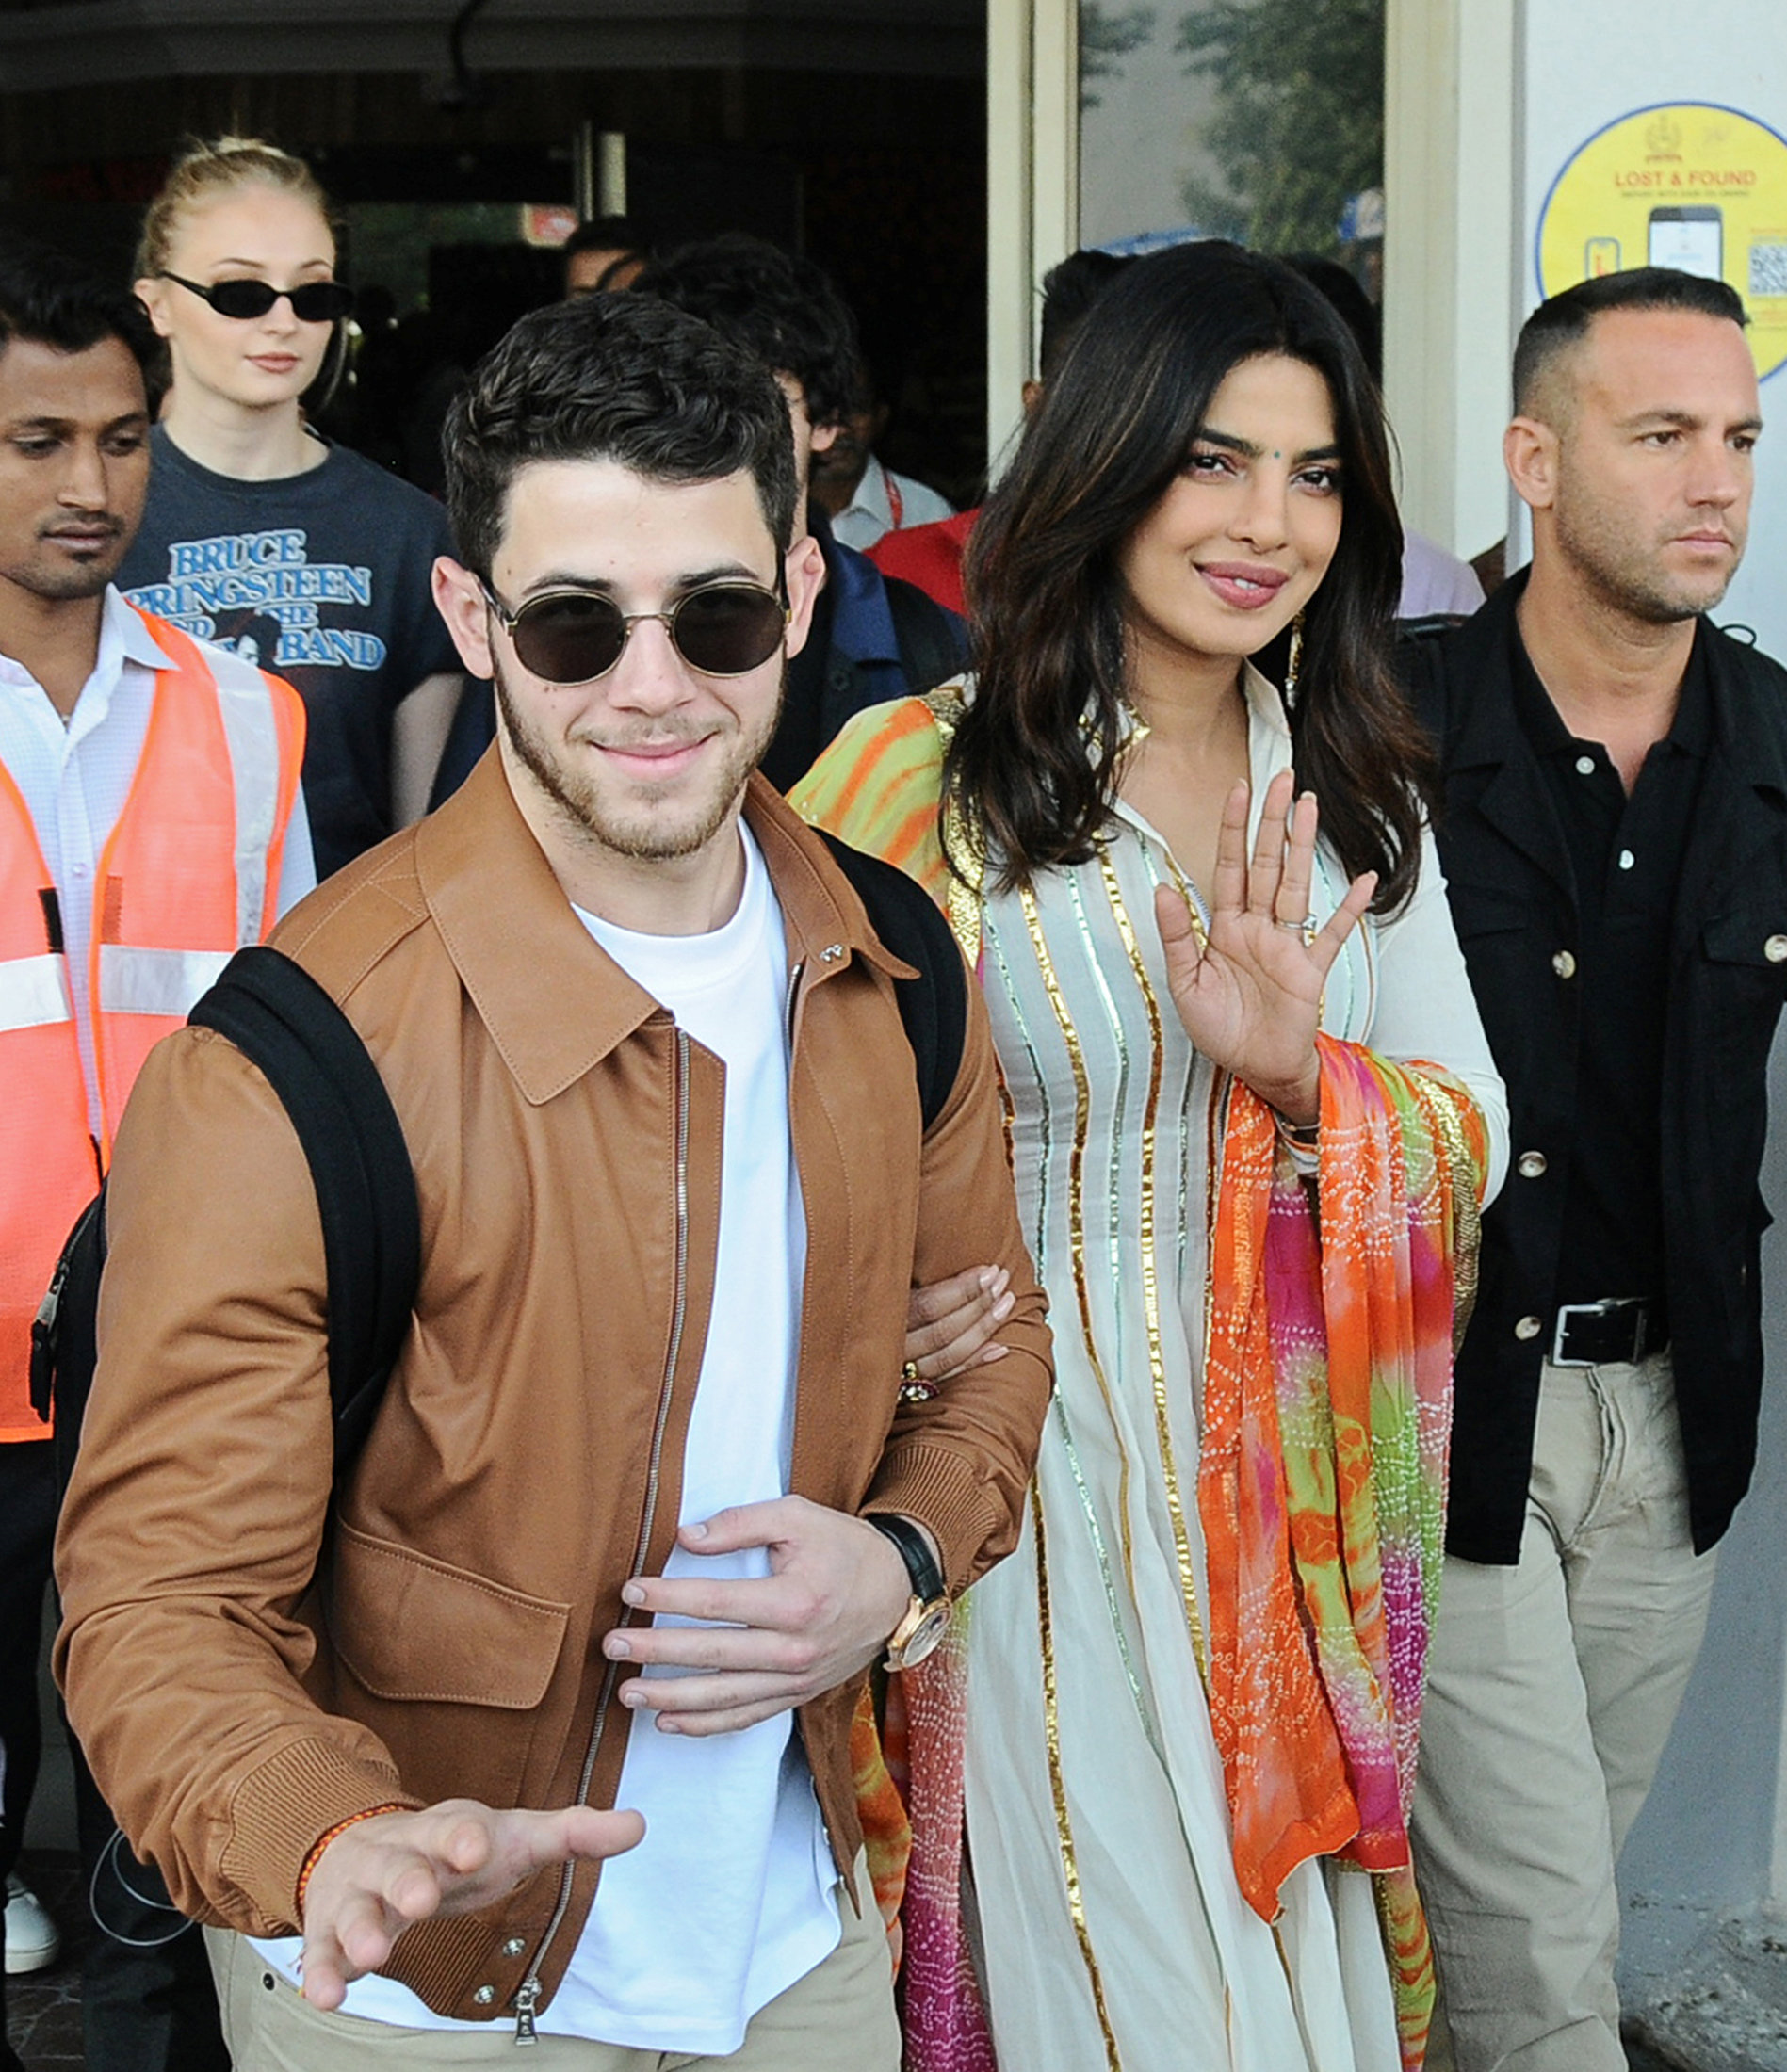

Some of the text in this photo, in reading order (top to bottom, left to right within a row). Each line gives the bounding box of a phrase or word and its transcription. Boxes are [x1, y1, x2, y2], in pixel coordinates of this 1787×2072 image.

[1615, 170, 1757, 186] LOST & FOUND
[169, 529, 306, 579] BRUCE
[122, 564, 371, 617] PRINGSTEEN
[273, 628, 385, 670] BAND
